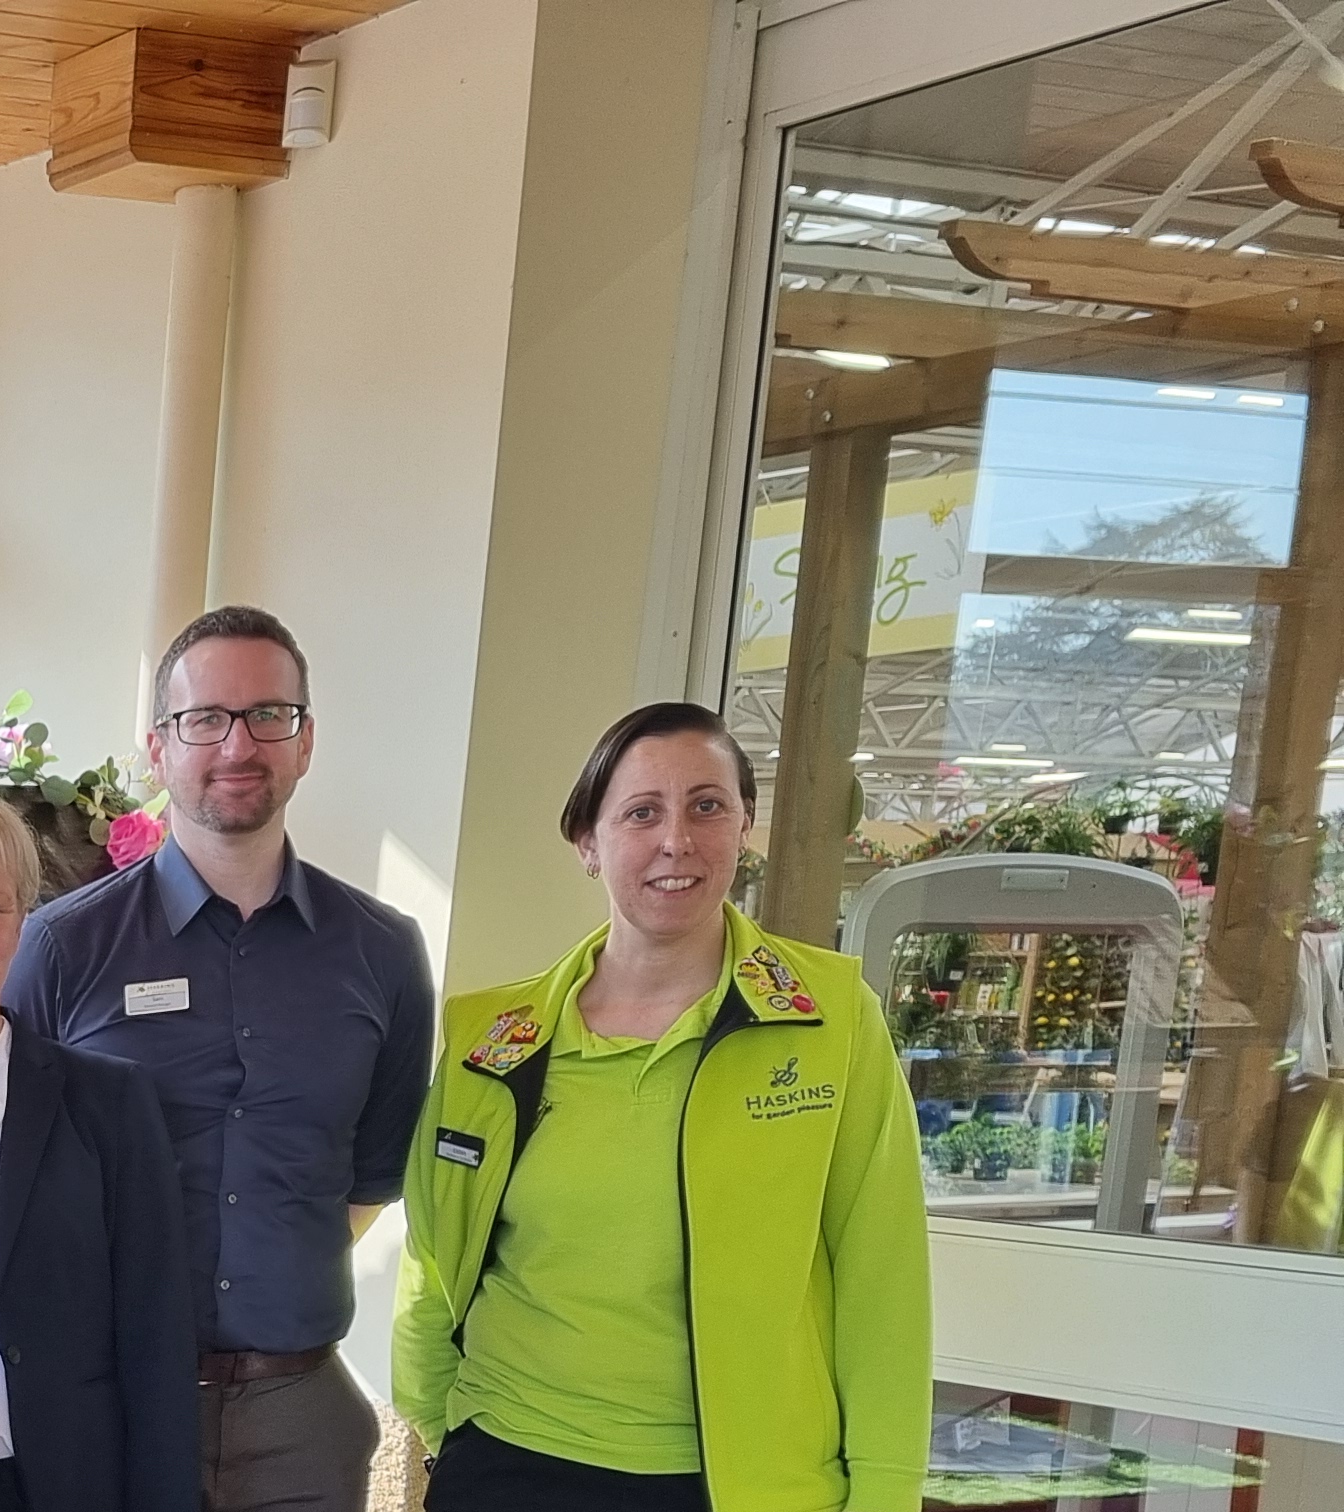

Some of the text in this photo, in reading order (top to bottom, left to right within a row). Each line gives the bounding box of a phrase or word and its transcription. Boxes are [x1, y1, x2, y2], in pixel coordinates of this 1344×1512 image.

[746, 1084, 835, 1110] HASKINS
[767, 1109, 795, 1119] garden
[797, 1103, 832, 1113] pleasure
